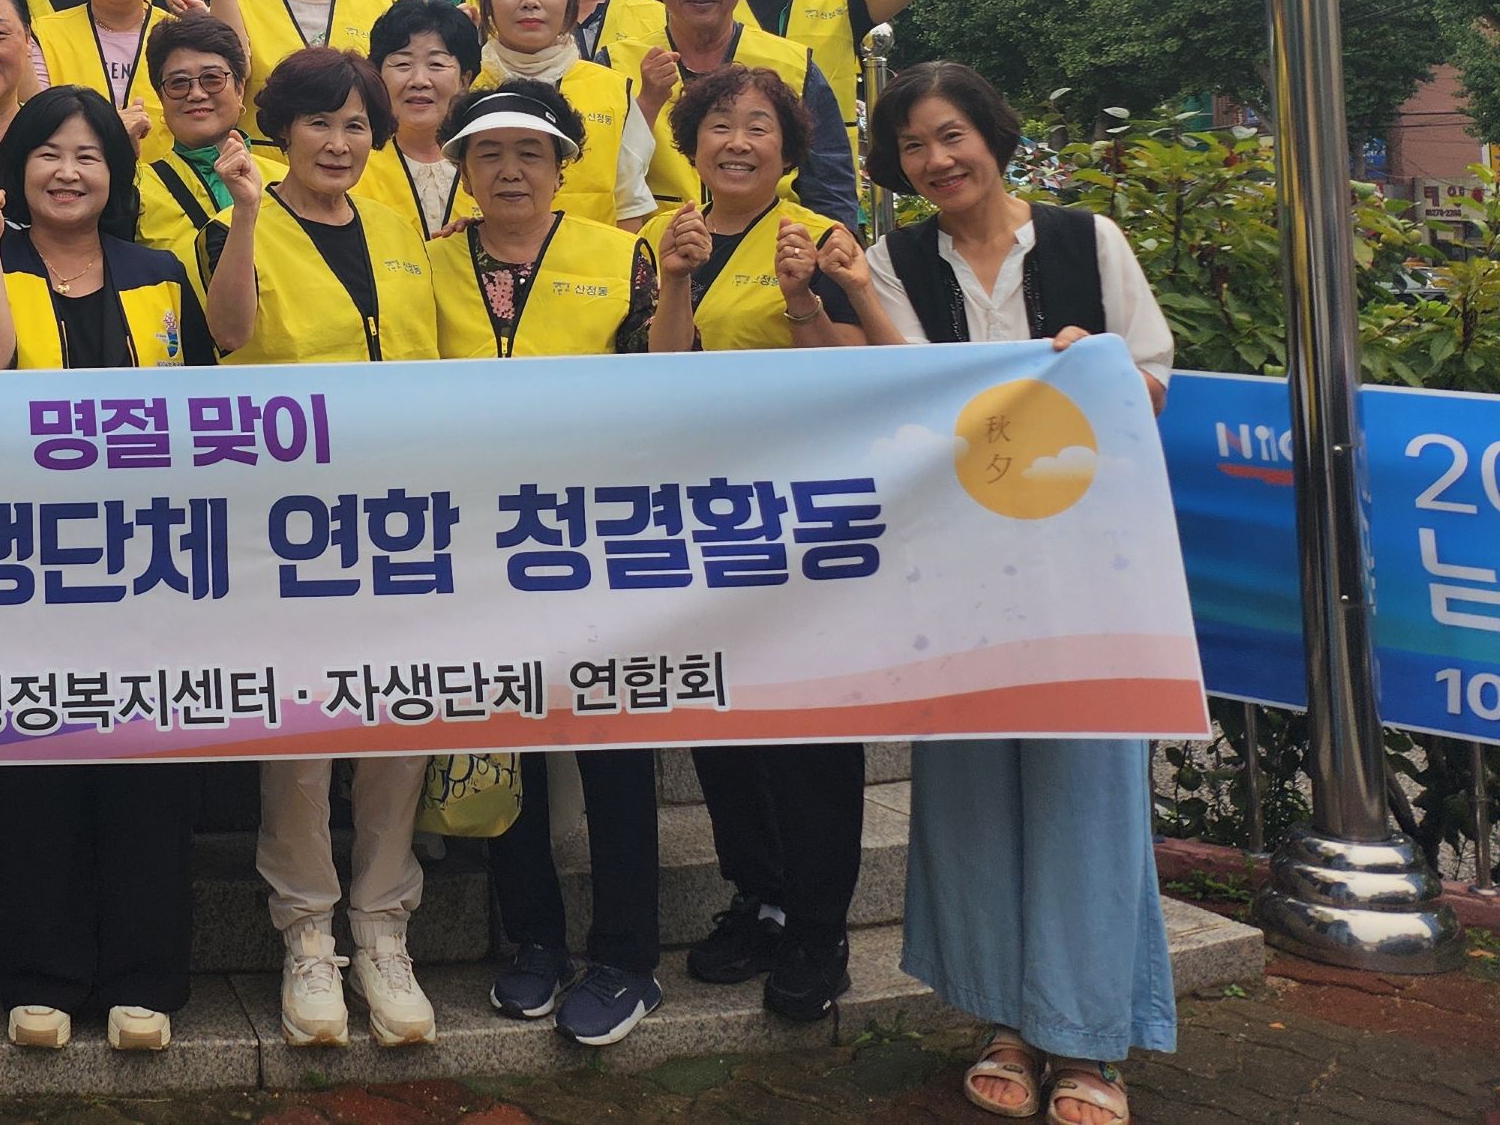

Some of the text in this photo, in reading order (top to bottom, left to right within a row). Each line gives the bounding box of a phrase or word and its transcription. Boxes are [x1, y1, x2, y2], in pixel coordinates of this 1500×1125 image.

[588, 113, 612, 125] 산정동
[575, 284, 608, 296] 산정동
[29, 394, 331, 470] 명절 맞이
[986, 415, 1012, 484] 秋夕
[268, 488, 460, 599] 연합
[495, 477, 887, 592] 청결활동
[325, 658, 543, 721] 자생단체
[569, 652, 727, 709] 연합회
